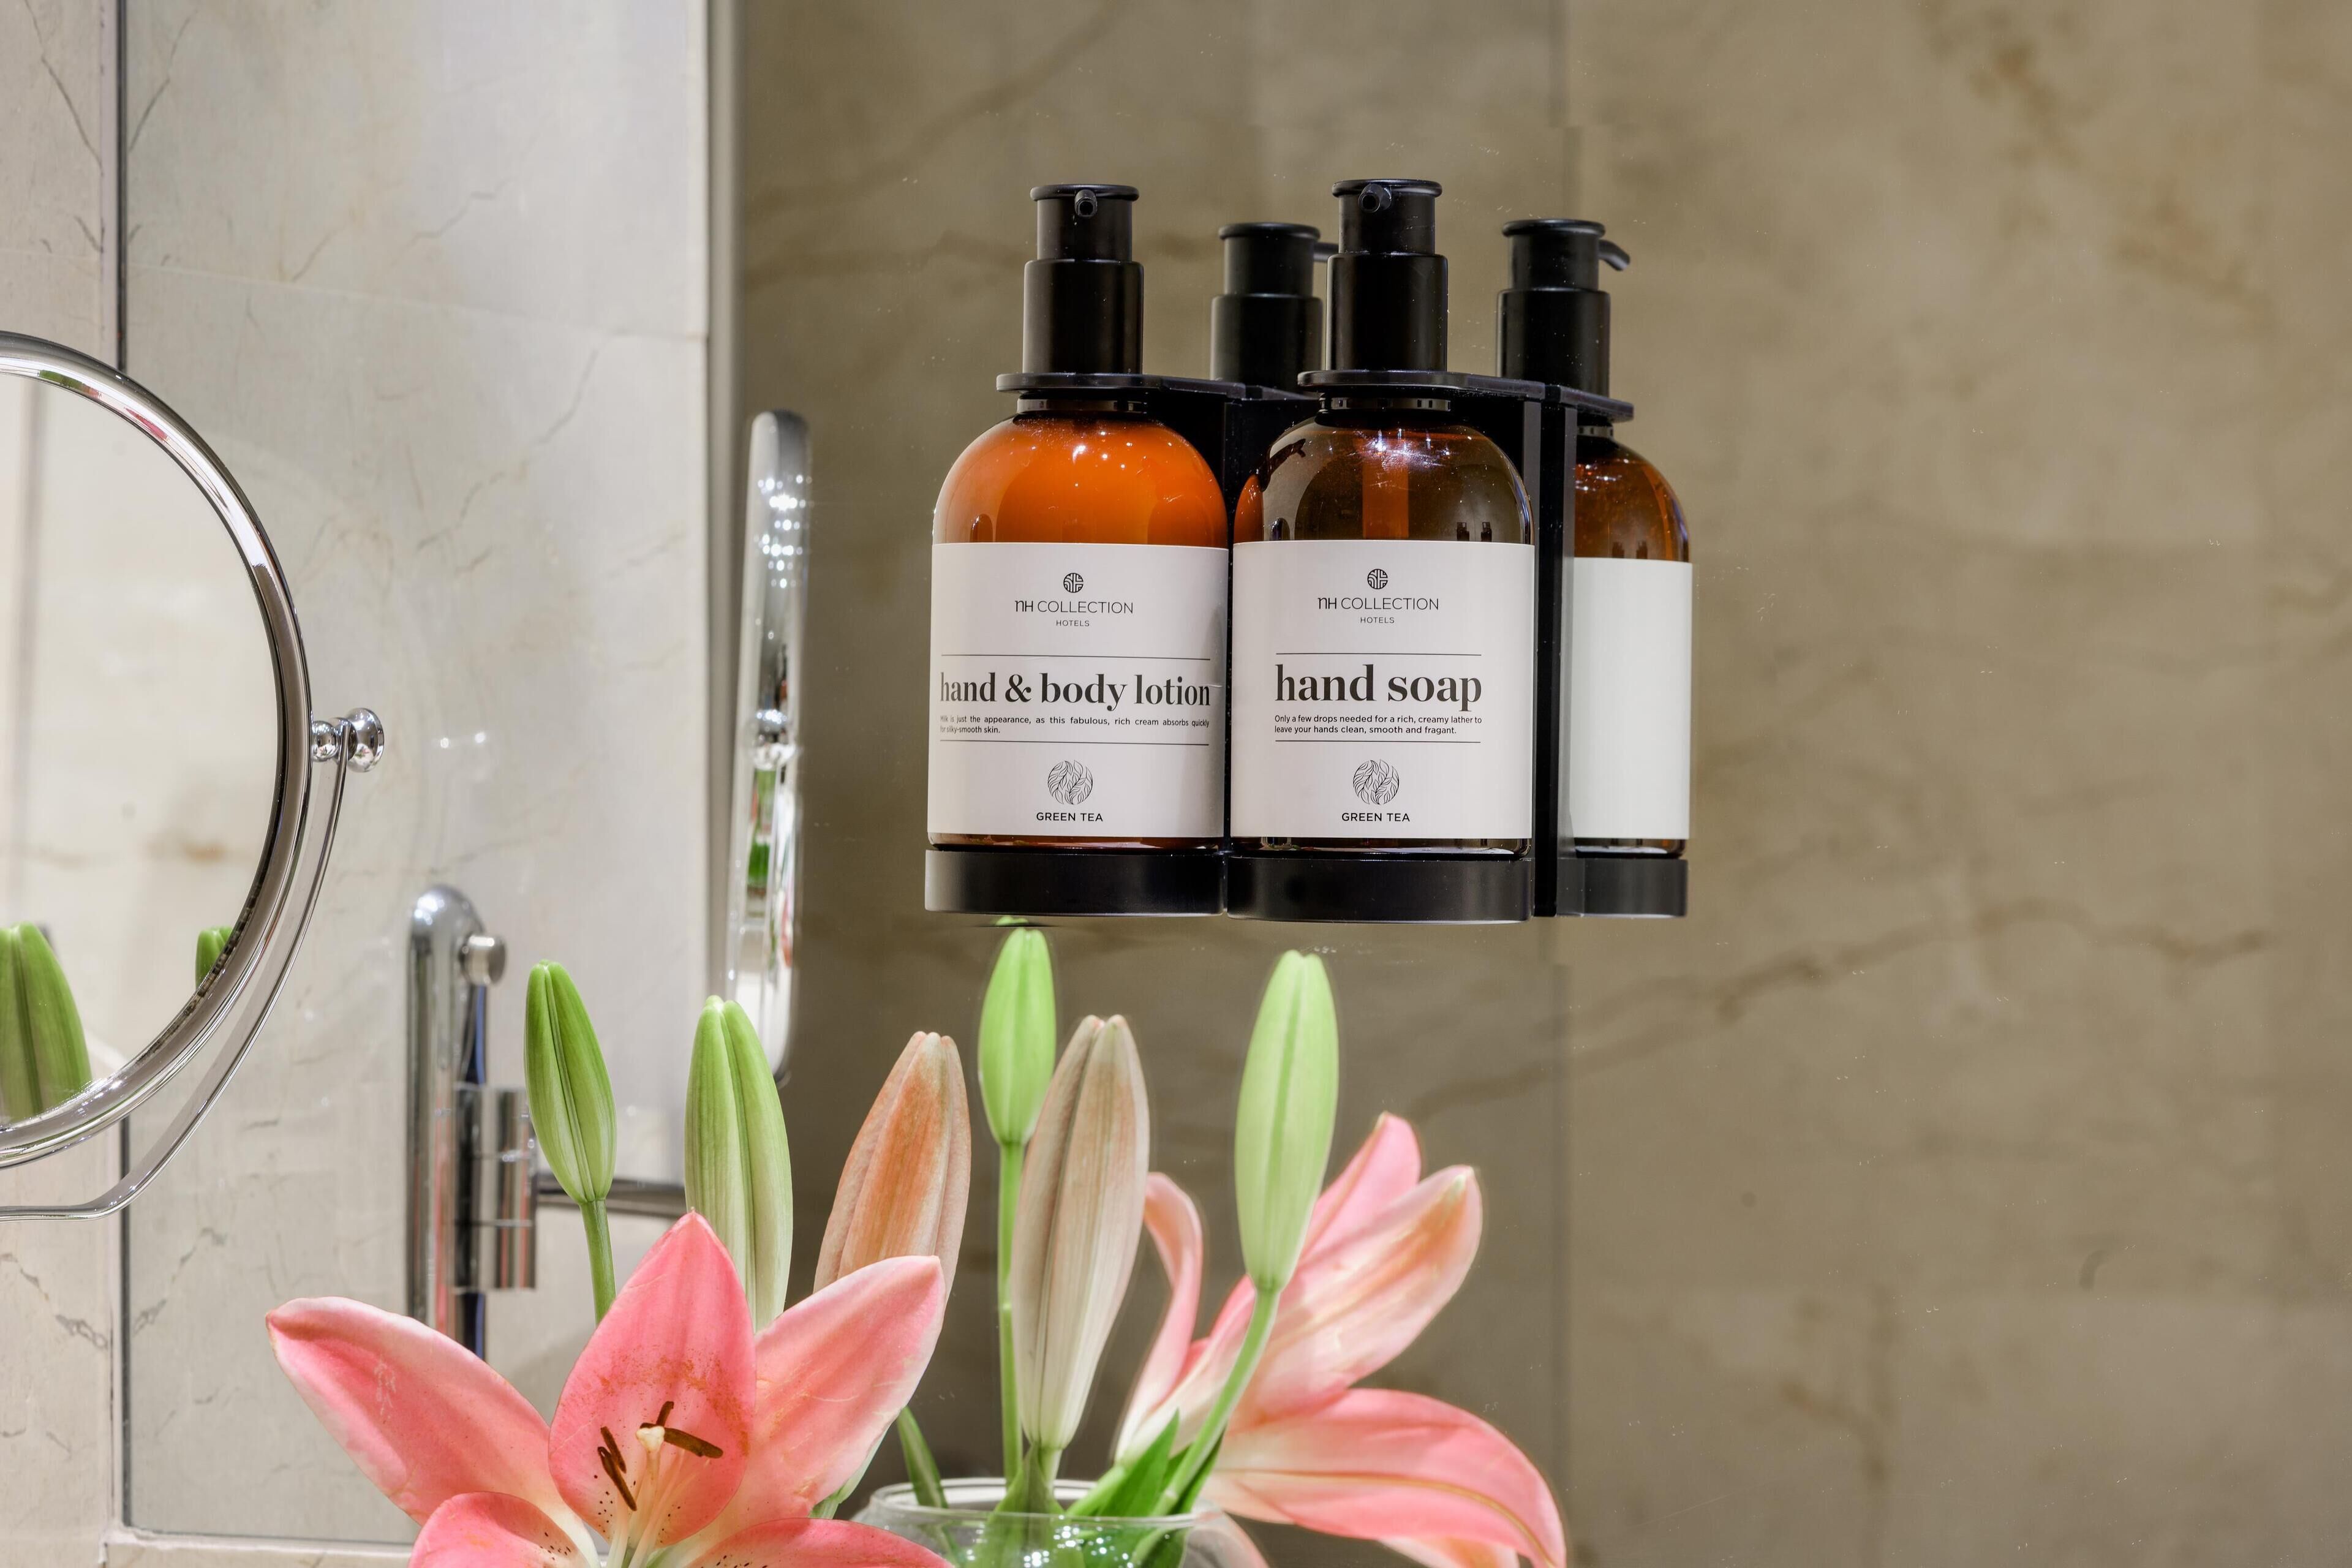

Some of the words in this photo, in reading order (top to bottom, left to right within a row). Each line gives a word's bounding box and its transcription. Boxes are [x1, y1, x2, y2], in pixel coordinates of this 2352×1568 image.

[1038, 601, 1133, 614] COLLECTION
[1341, 598, 1438, 610] COLLECTION
[941, 672, 997, 702] hand
[1005, 674, 1031, 703] &
[1039, 673, 1127, 711] body
[1134, 674, 1212, 706] lotion
[1275, 664, 1376, 701] hand
[1388, 677, 1481, 712] soap
[1071, 717, 1109, 725] fabulous,
[1193, 719, 1210, 728] quickly
[1275, 715, 1291, 723] Only
[1314, 715, 1337, 723] drops
[1398, 715, 1415, 724] rich,
[1425, 726, 1458, 734] fragant.
[1036, 812, 1076, 821] GREEN
[1080, 813, 1102, 821] TEA
[1342, 813, 1382, 821] GREEN
